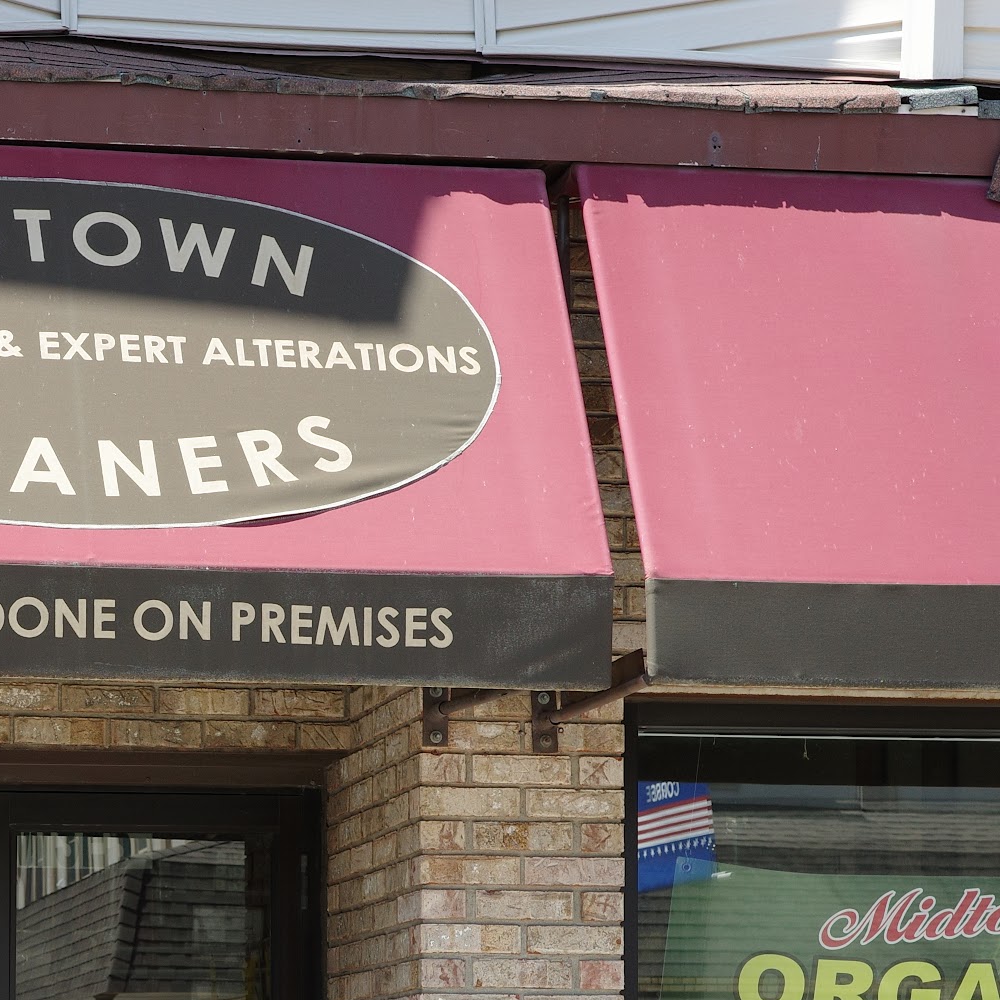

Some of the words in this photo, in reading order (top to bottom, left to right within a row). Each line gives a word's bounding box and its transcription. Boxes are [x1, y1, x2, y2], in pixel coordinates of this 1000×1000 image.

[38, 332, 187, 364] EXPERT
[202, 338, 482, 376] ALTERATIONS
[133, 600, 212, 642] ON
[231, 601, 454, 649] PREMISES
